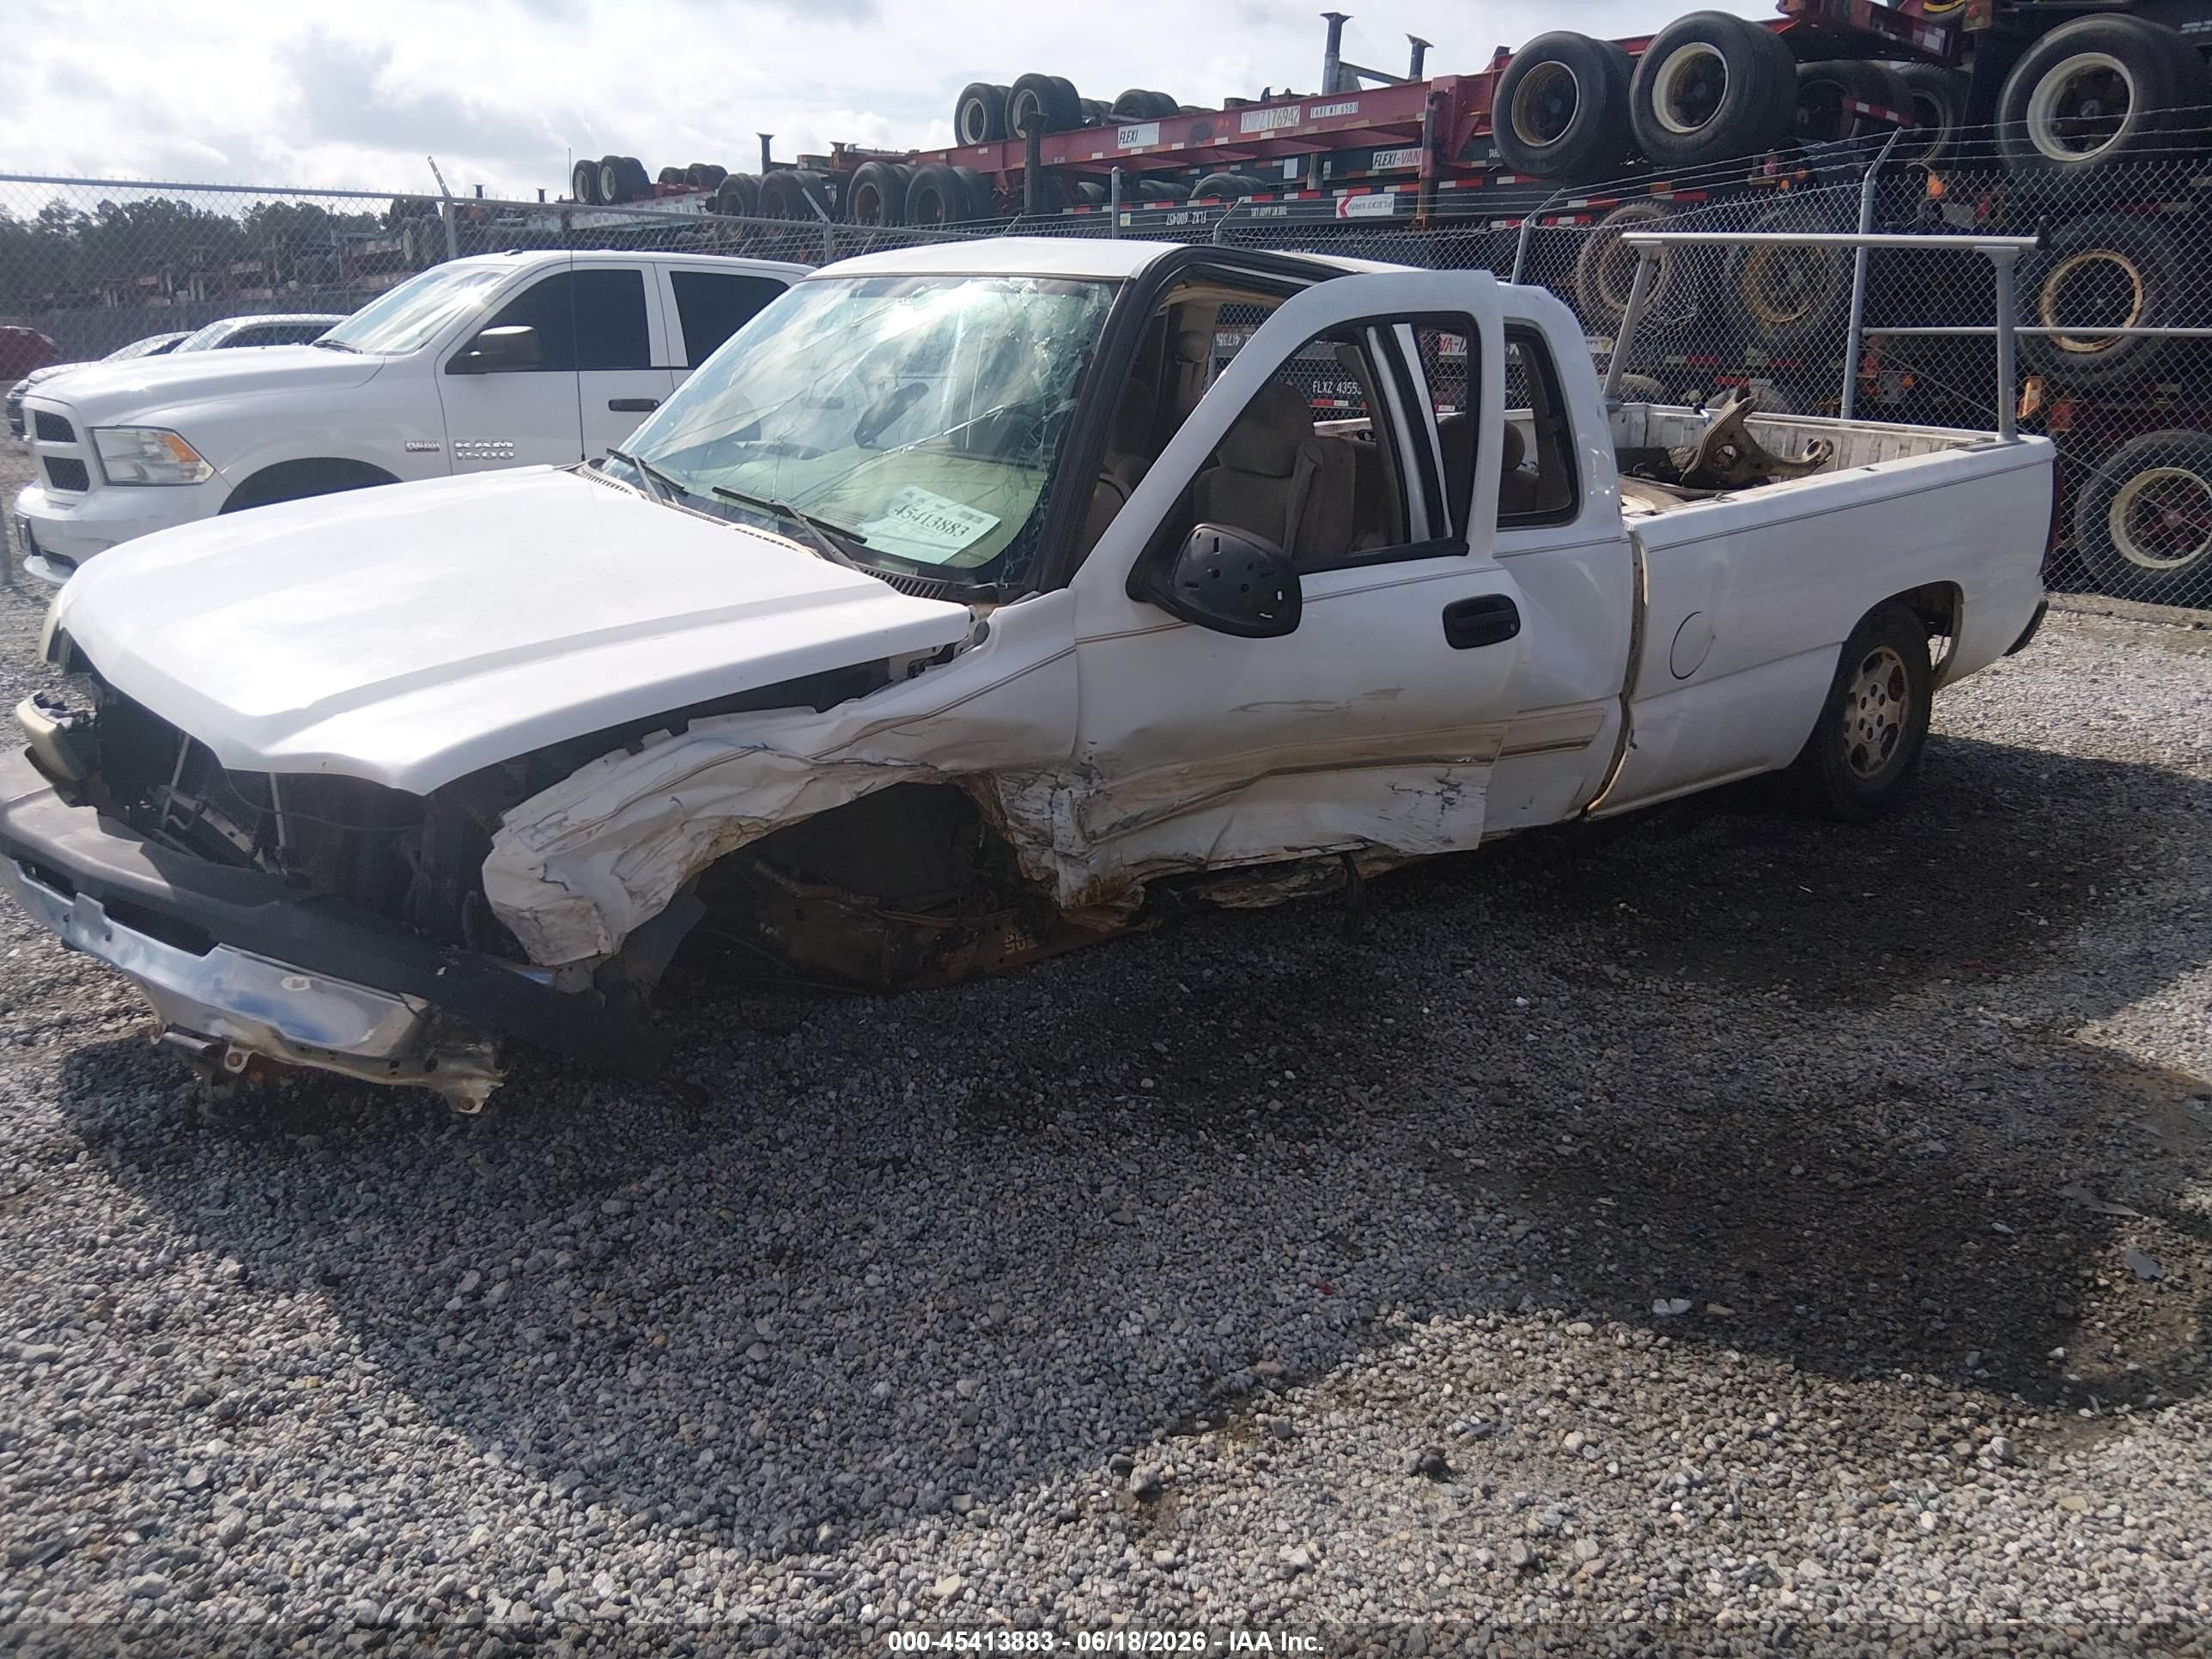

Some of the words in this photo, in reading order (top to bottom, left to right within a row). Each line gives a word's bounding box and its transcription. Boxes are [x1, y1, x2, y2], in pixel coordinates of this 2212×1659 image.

[1340, 103, 1358, 112] 6500
[1118, 130, 1139, 145] FLEXI
[1374, 149, 1421, 167] FLEXI-VAN
[1192, 211, 1206, 225] FLXZ
[1312, 380, 1333, 394] FLXZ
[453, 440, 515, 449] RAM
[455, 450, 515, 460] 1500
[893, 503, 970, 538] 45413883
